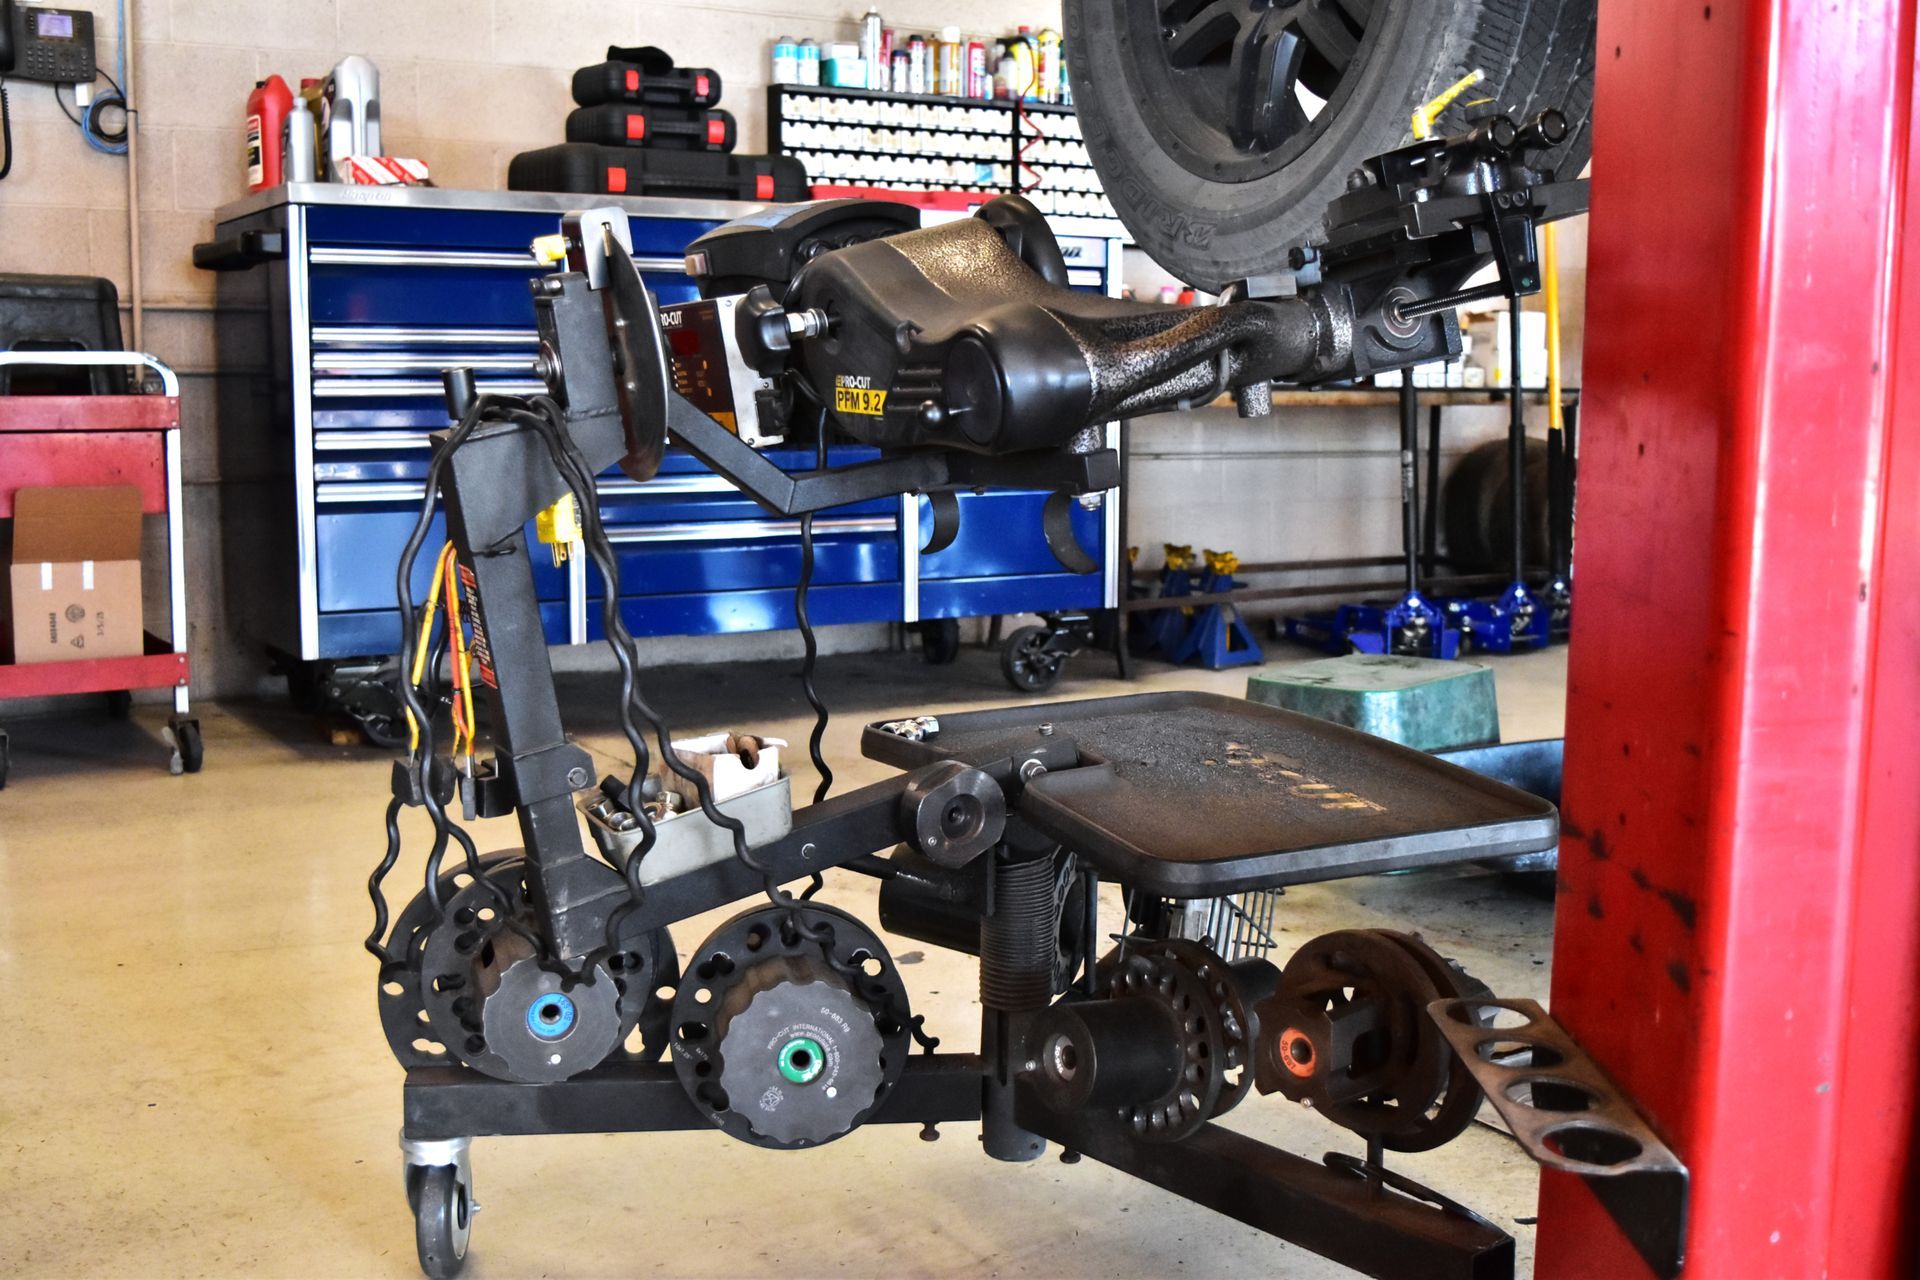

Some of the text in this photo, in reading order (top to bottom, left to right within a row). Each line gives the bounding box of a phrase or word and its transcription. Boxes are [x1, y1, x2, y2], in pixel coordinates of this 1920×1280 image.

[660, 310, 682, 327] RO-CUT
[836, 375, 871, 390] PRO-CUT
[837, 390, 881, 412] PFM 9.2
[793, 1023, 834, 1045] INTERNATIONAL
